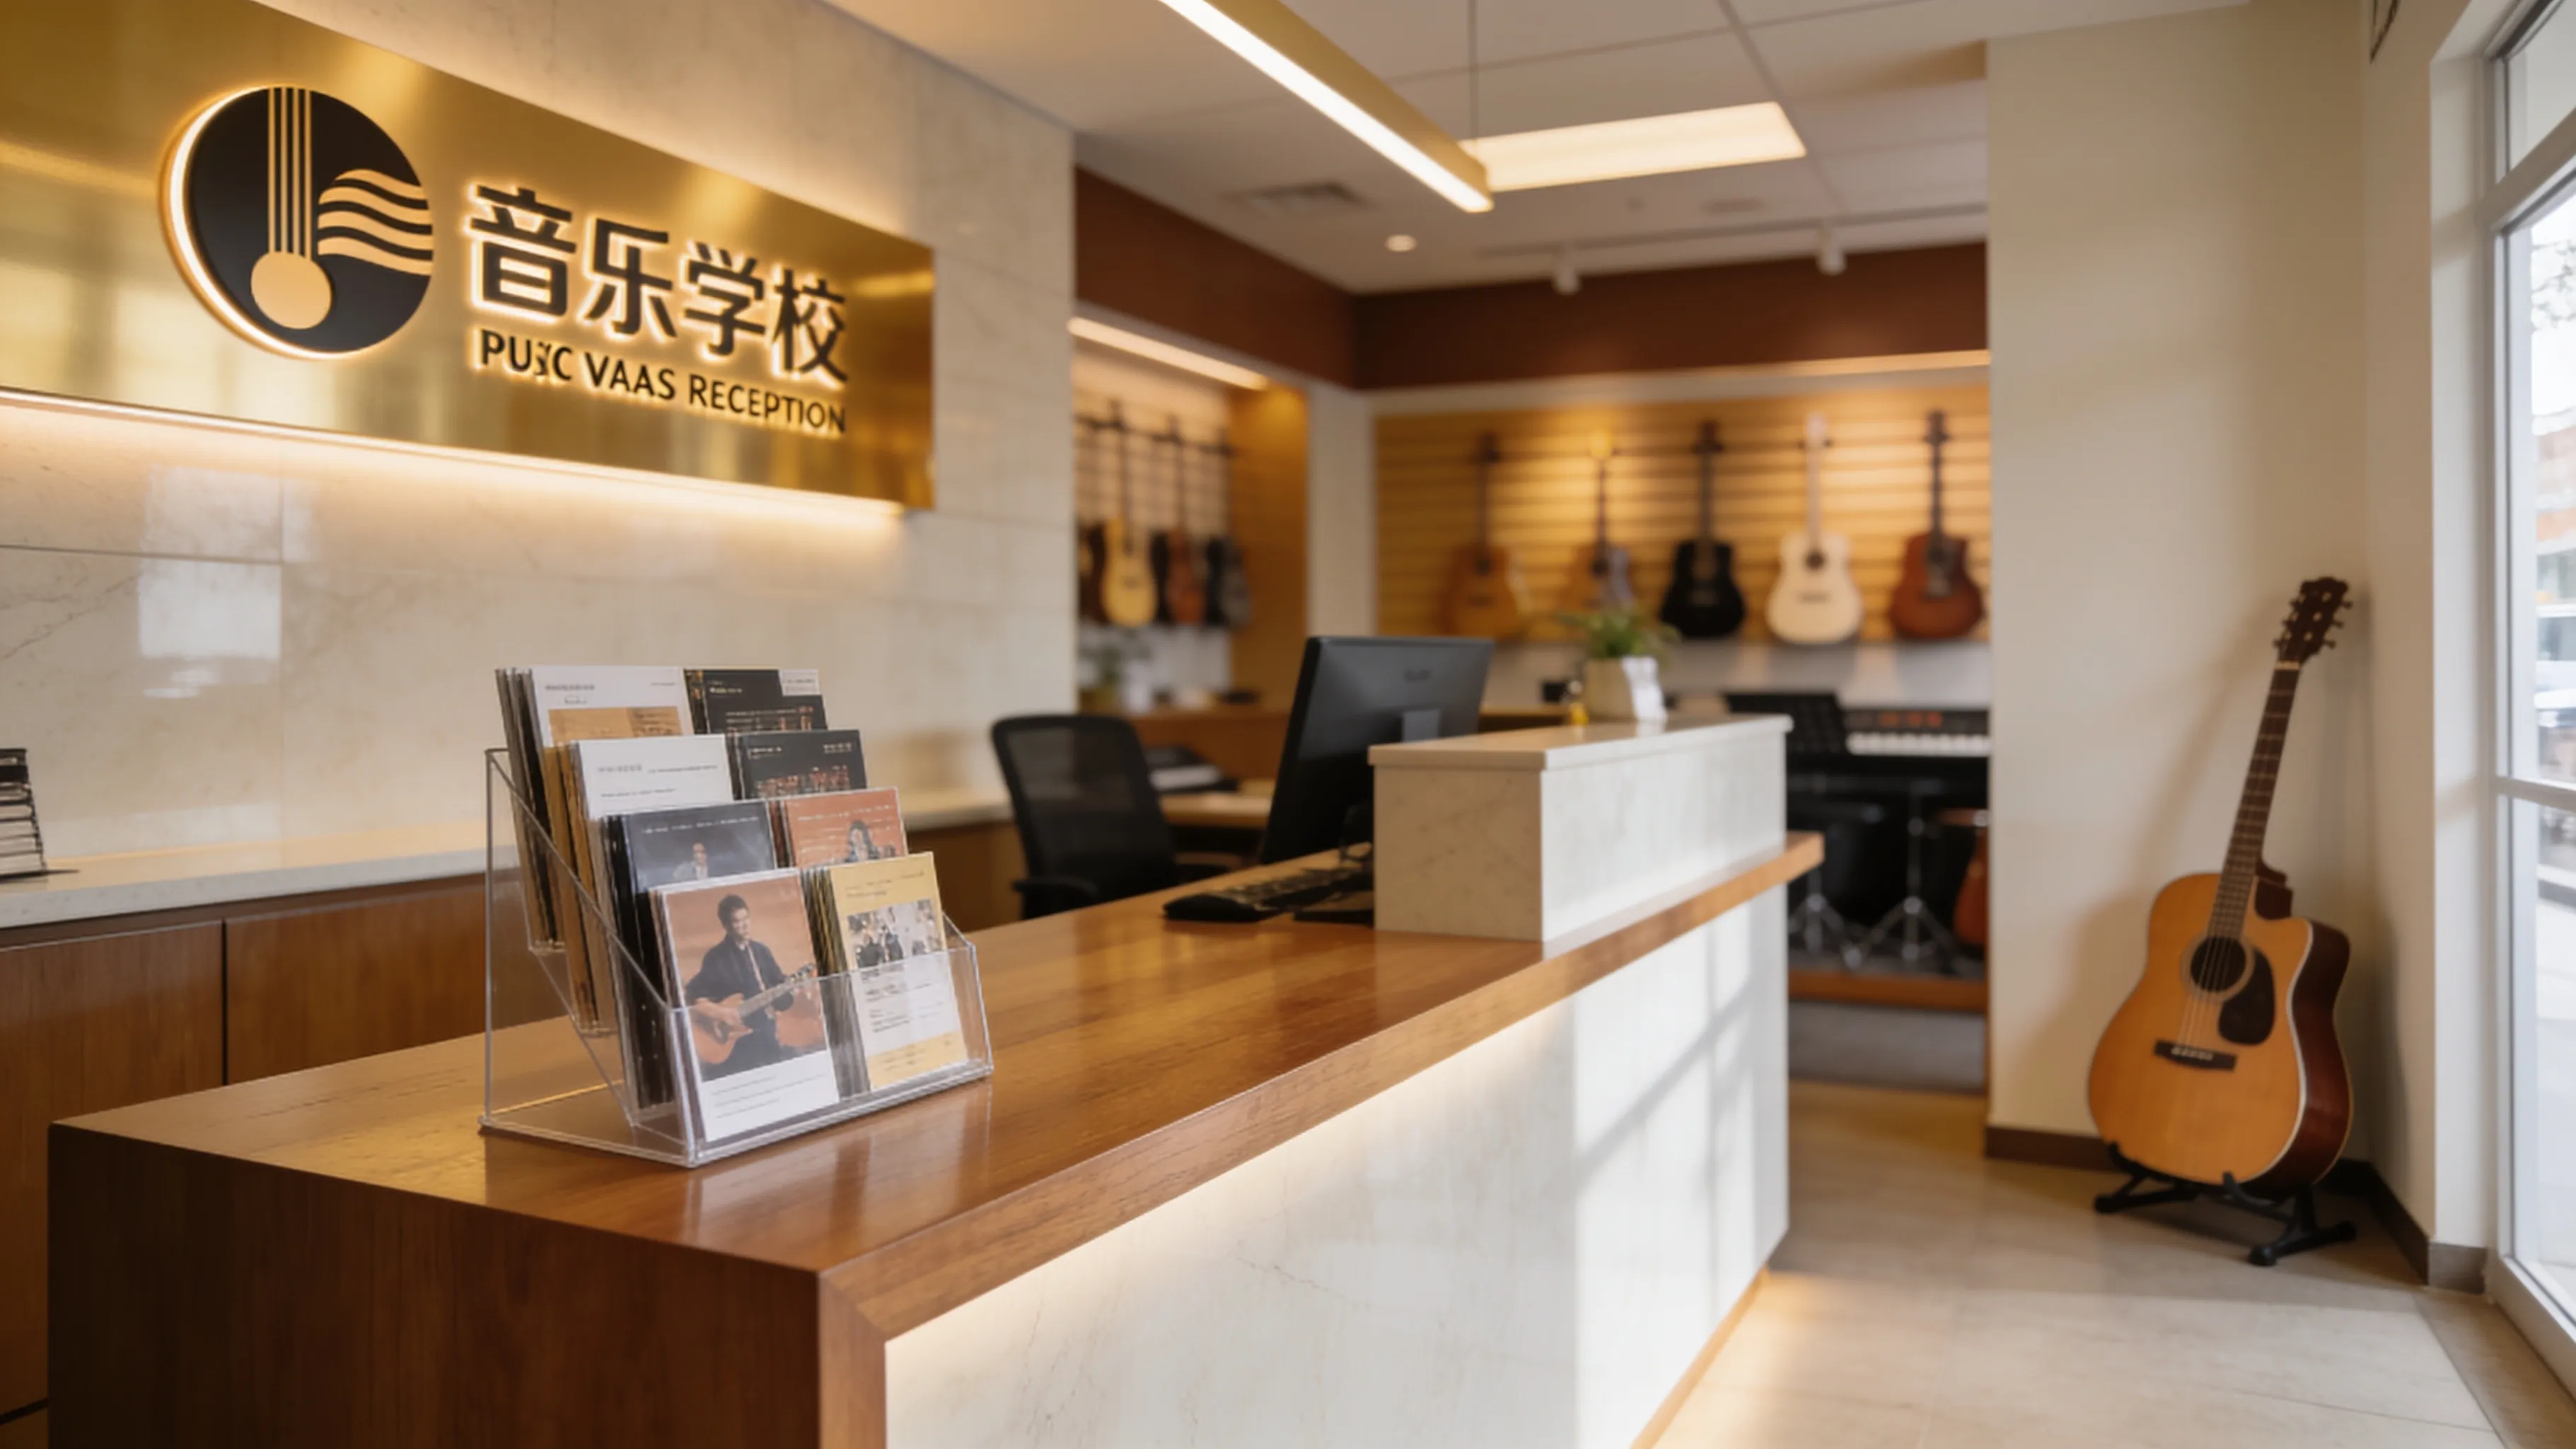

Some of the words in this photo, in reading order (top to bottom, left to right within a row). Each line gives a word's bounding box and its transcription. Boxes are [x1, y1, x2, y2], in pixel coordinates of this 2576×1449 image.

[469, 184, 849, 386] 音乐学校
[584, 352, 676, 401] VAAS
[688, 373, 847, 433] RECEPTION
